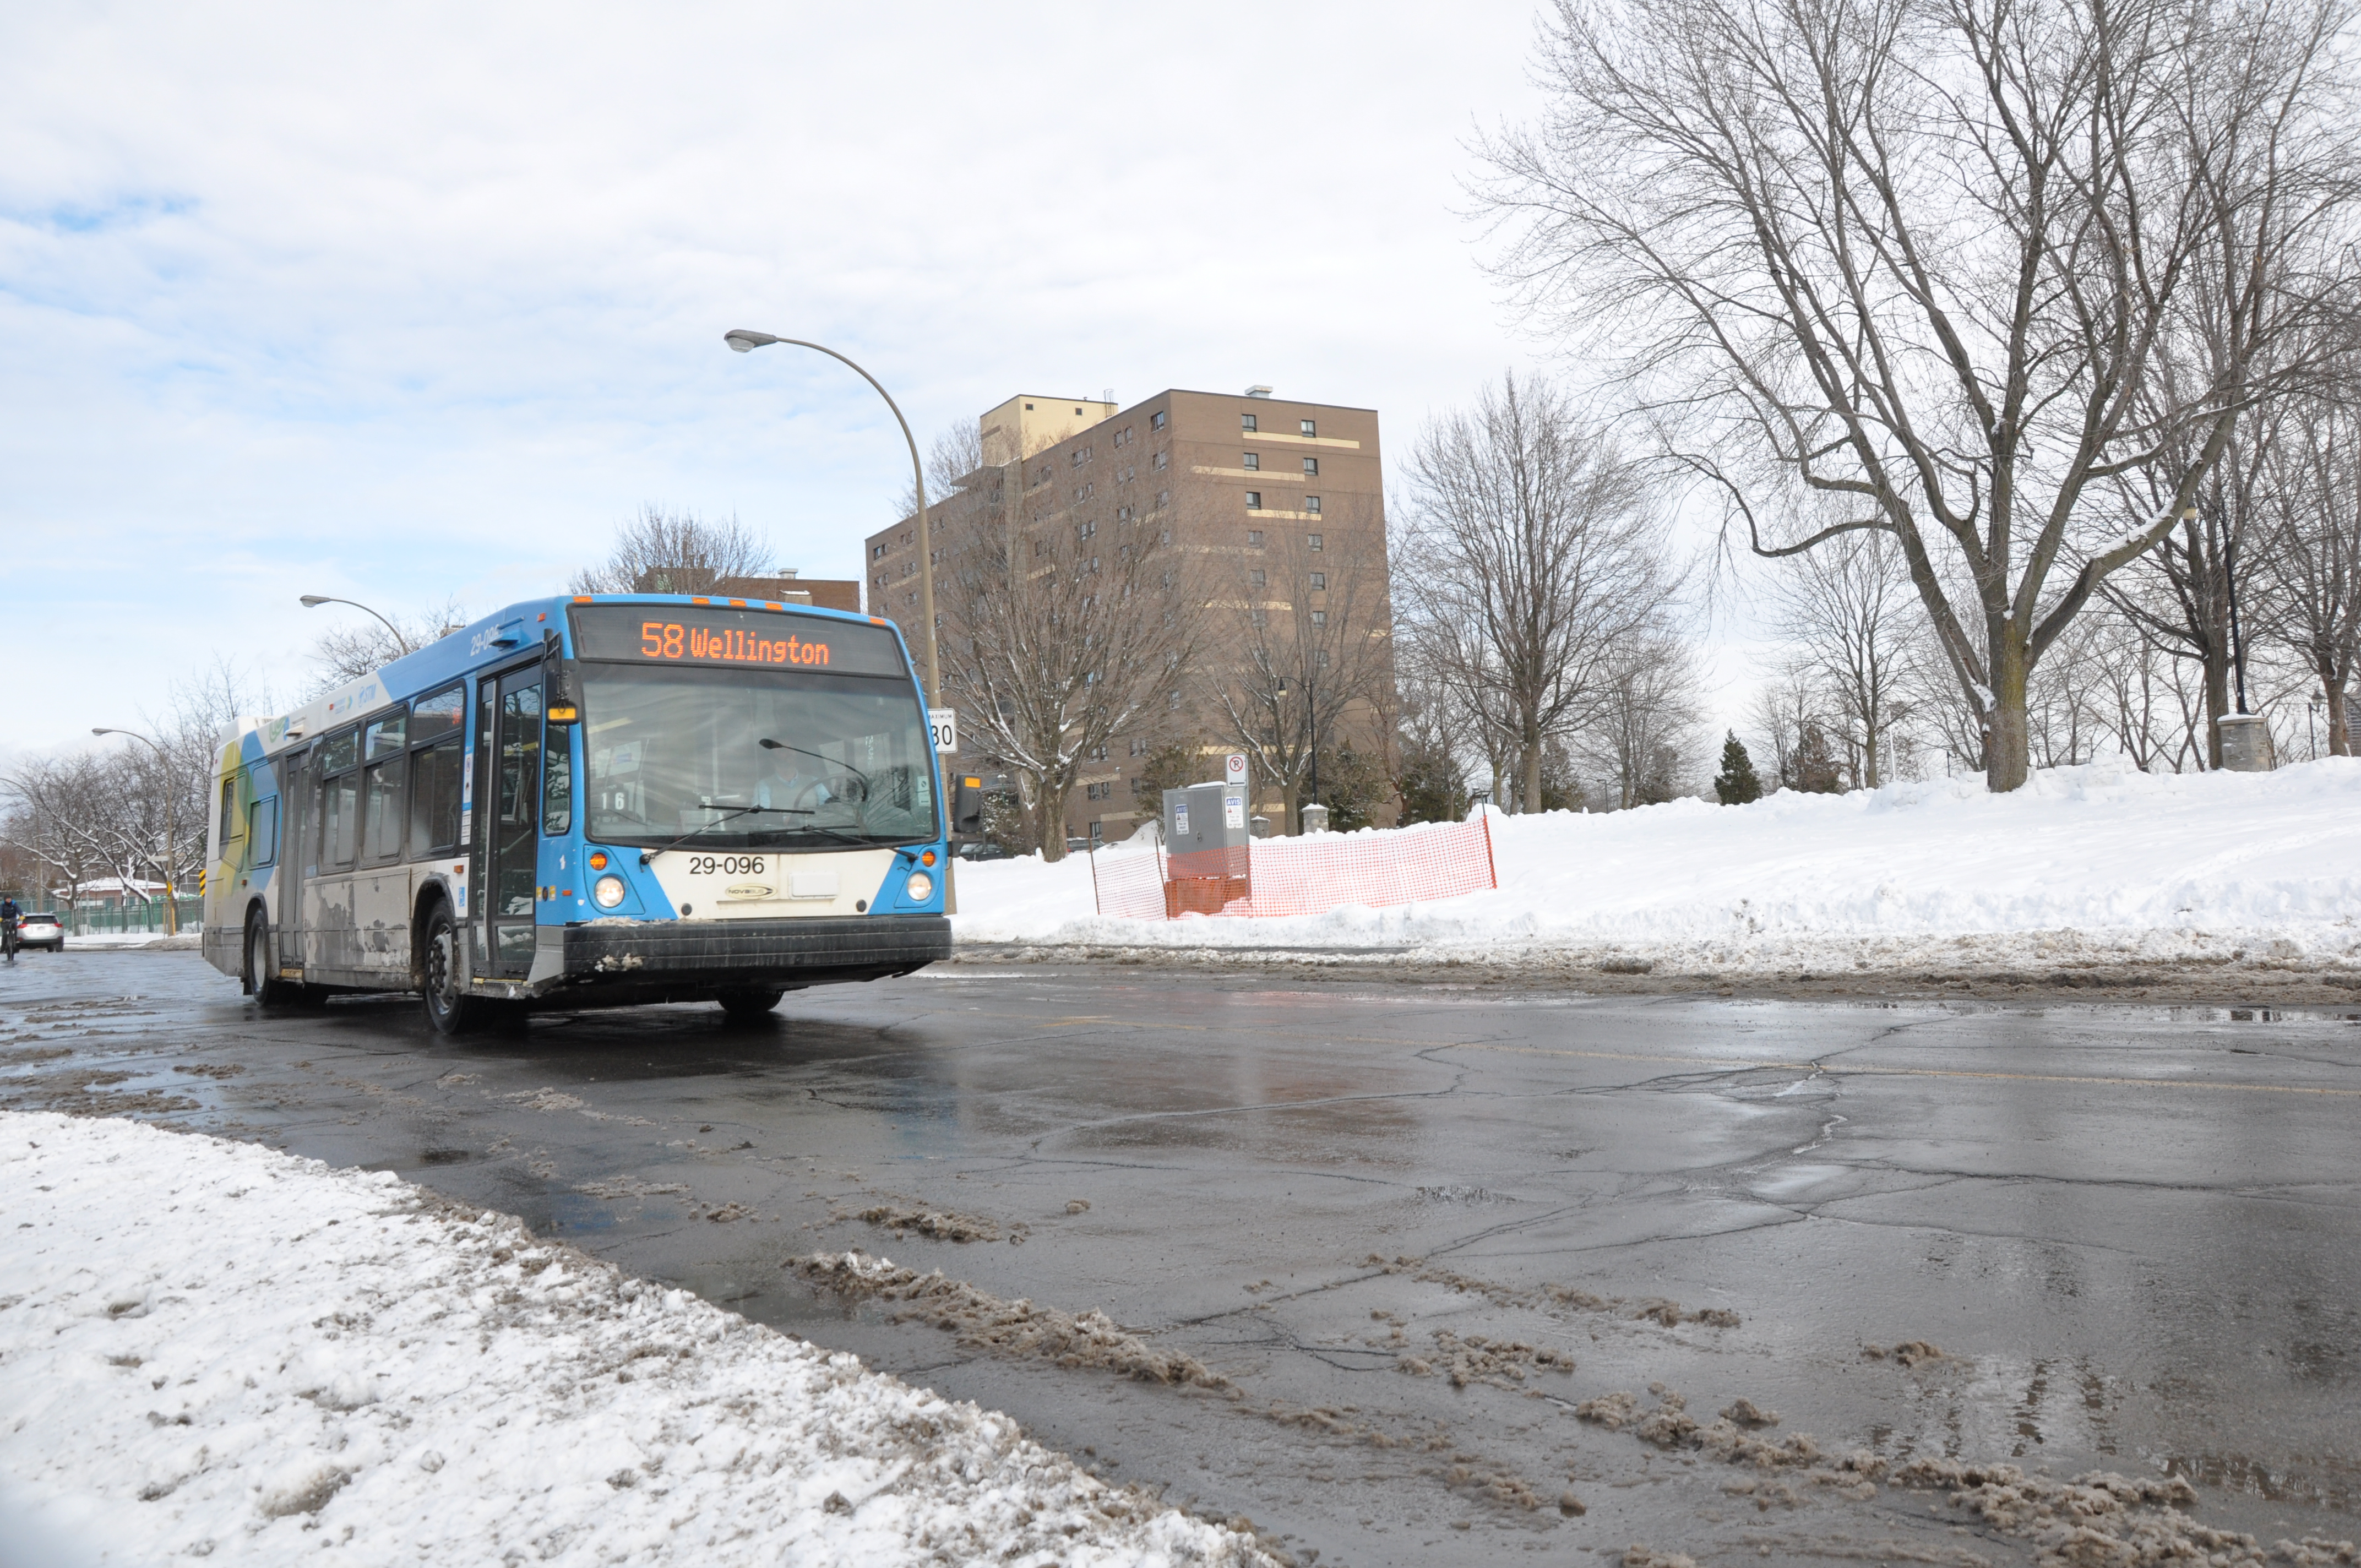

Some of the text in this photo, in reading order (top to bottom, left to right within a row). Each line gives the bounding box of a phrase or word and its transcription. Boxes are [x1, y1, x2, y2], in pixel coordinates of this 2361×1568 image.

[641, 622, 829, 665] 58 Wellington
[689, 856, 765, 874] 29-096
